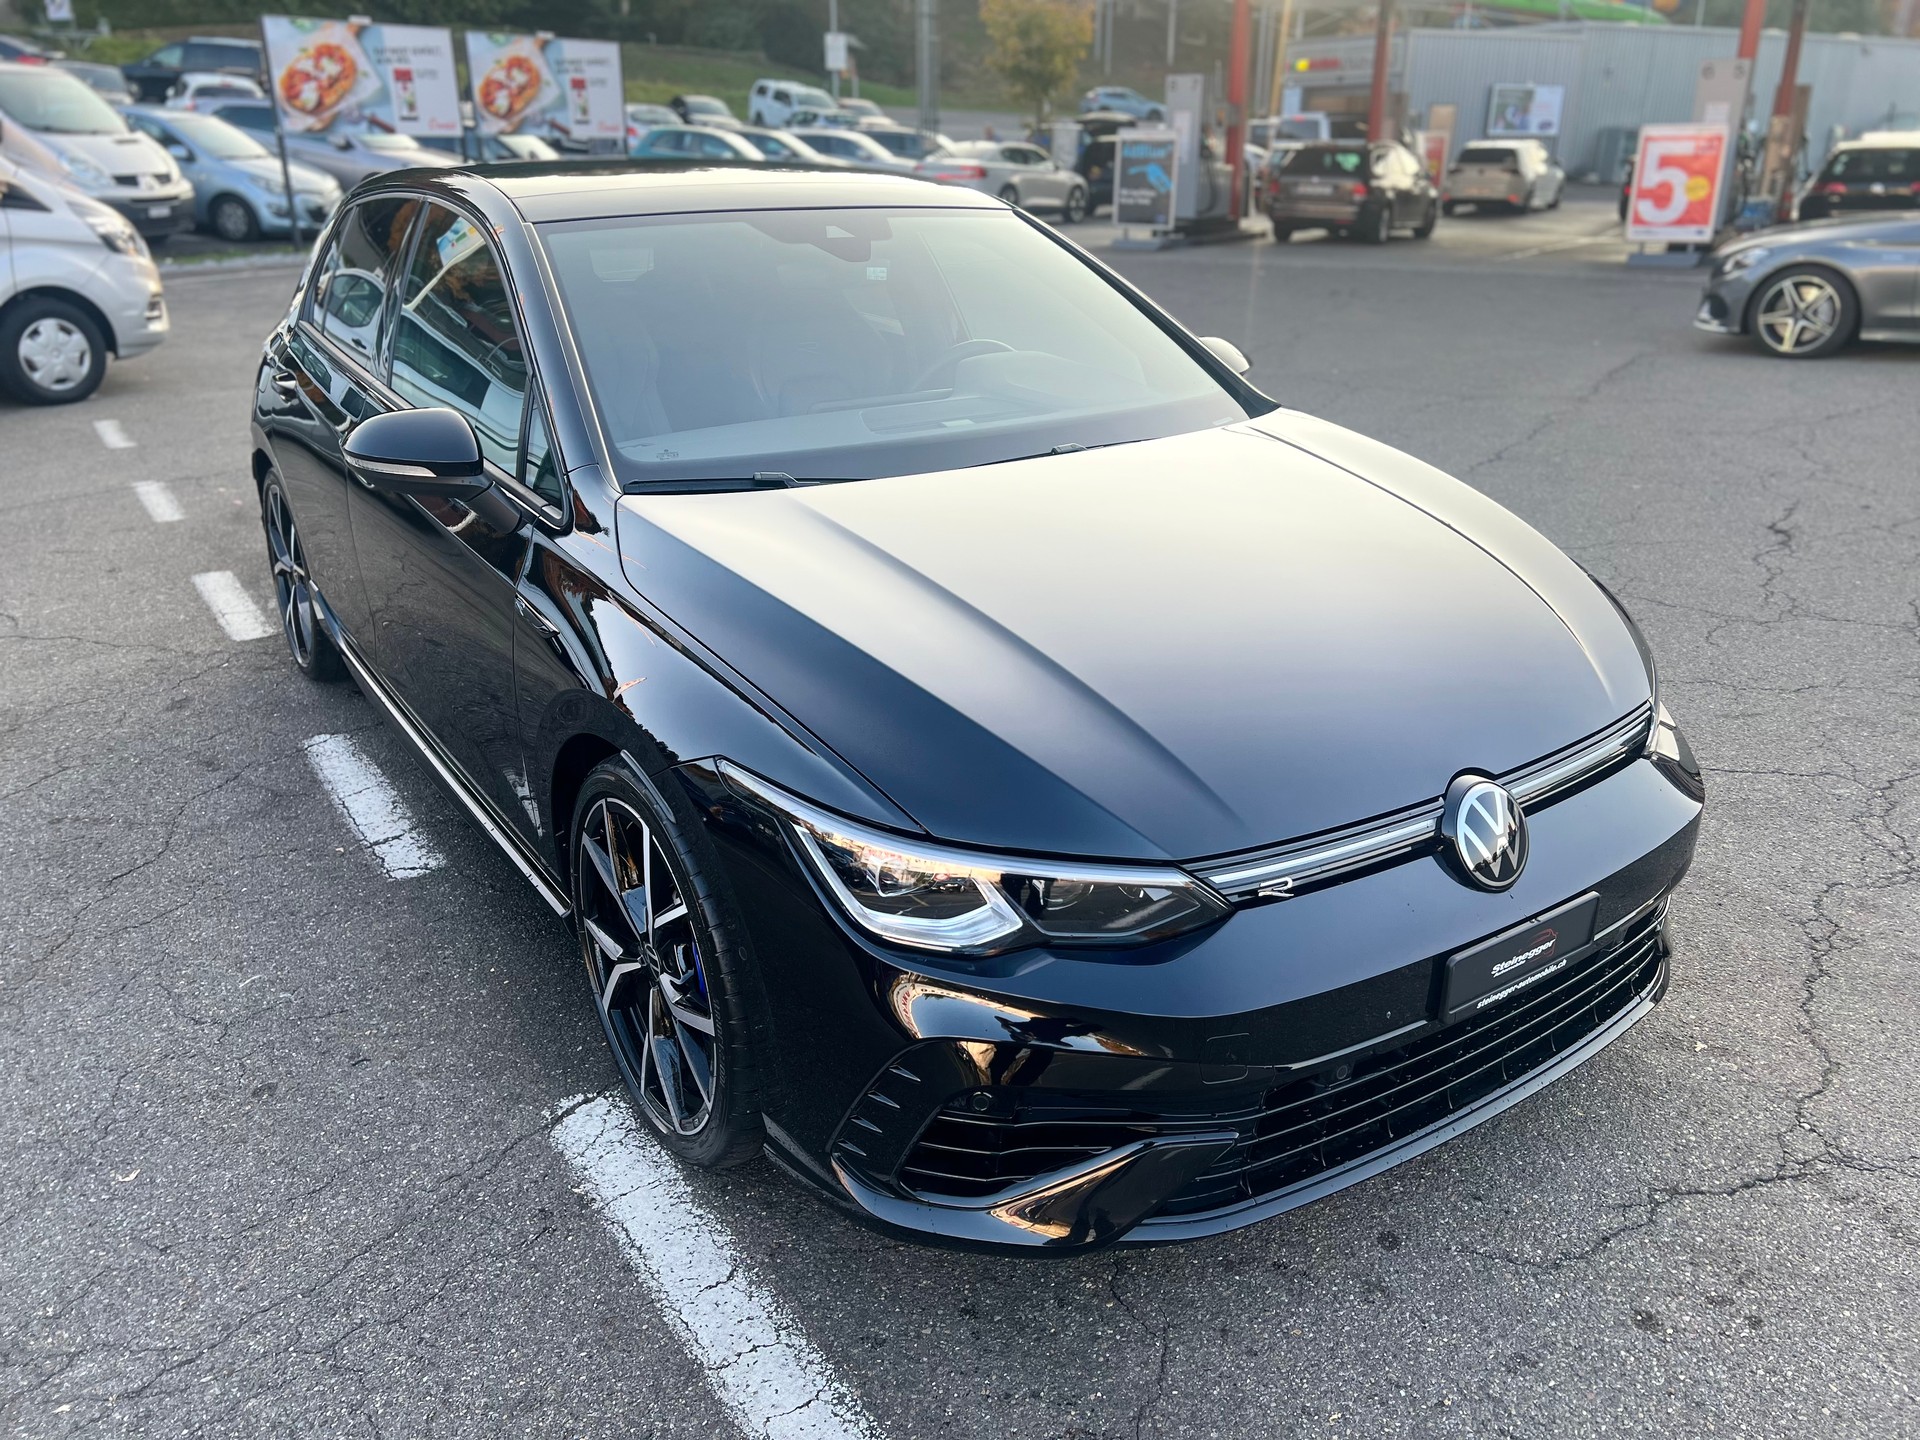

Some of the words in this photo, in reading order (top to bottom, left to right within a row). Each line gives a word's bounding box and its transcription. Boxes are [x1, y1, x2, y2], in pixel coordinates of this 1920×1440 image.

[1636, 140, 1697, 225] 5
[1258, 877, 1295, 897] R
[1491, 938, 1556, 975] Steinegger
